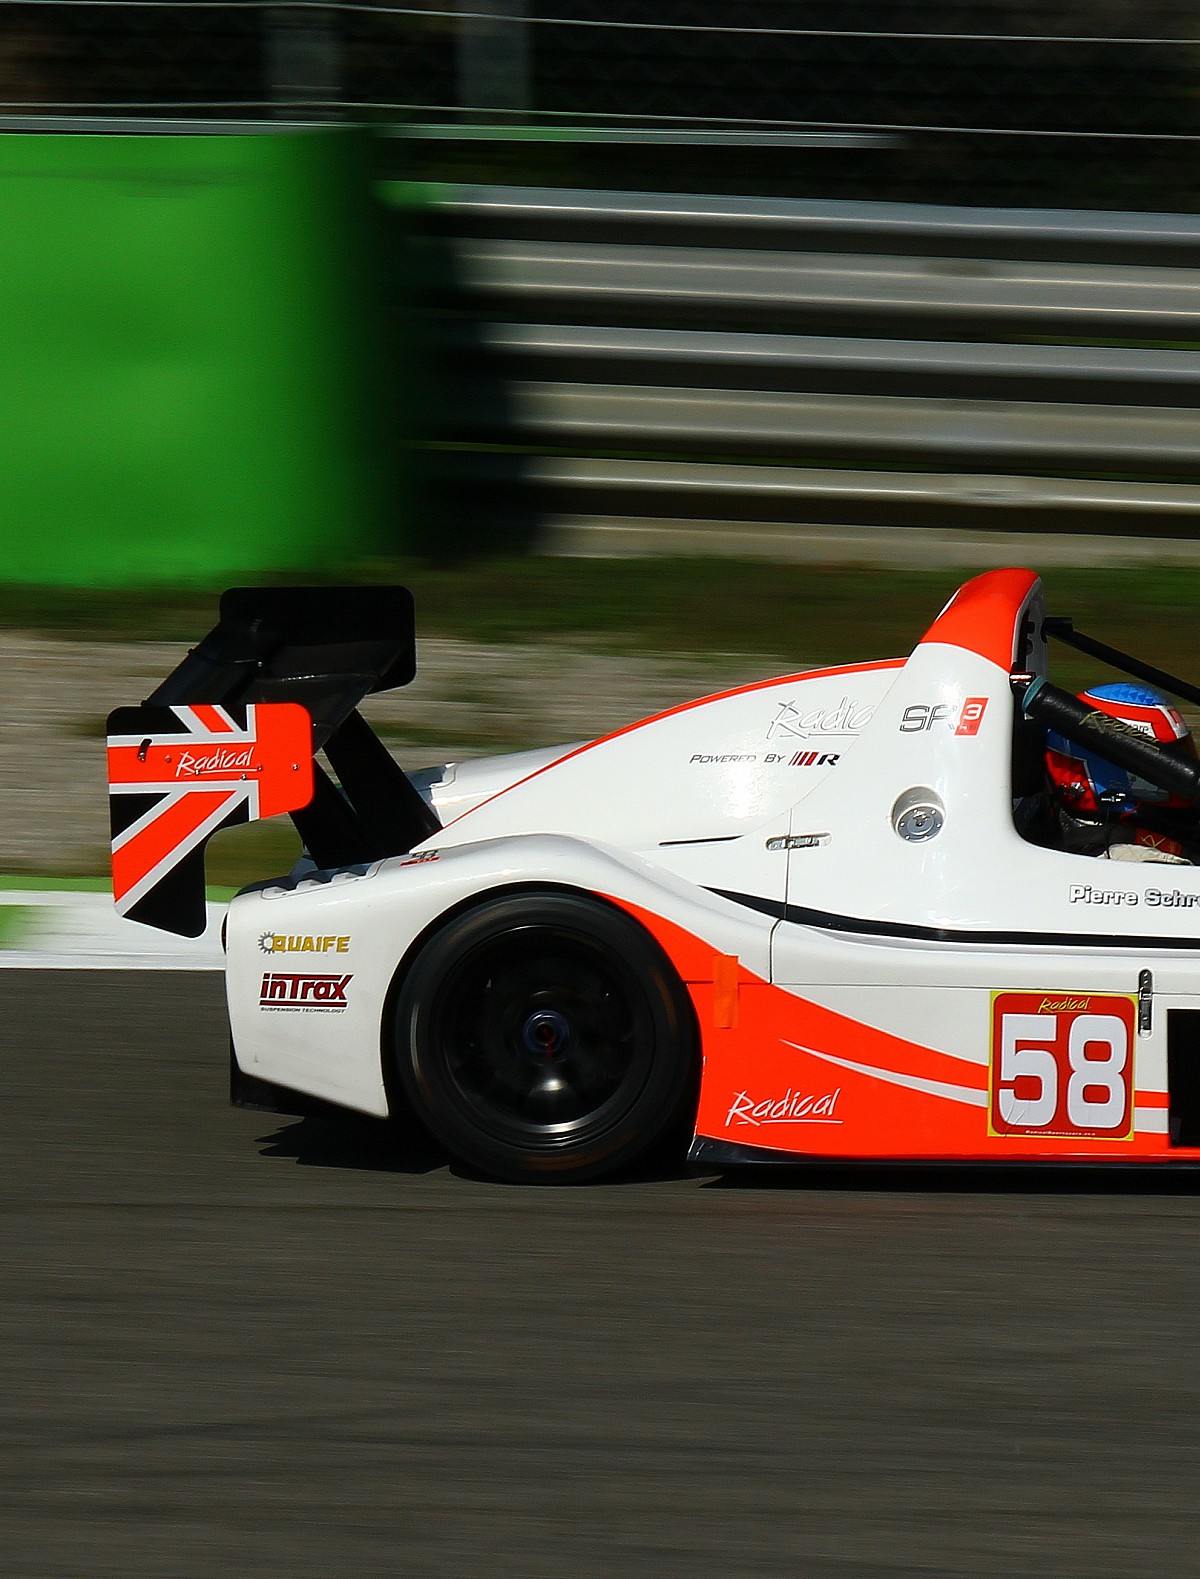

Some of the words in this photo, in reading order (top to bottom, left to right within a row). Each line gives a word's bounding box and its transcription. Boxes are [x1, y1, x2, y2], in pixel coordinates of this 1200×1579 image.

[175, 746, 258, 777] Radical
[1069, 885, 1138, 906] Pierre
[272, 935, 351, 953] QUAIFE
[1038, 997, 1092, 1014] Radical
[999, 1013, 1128, 1129] 58
[725, 1088, 843, 1126] Radical
